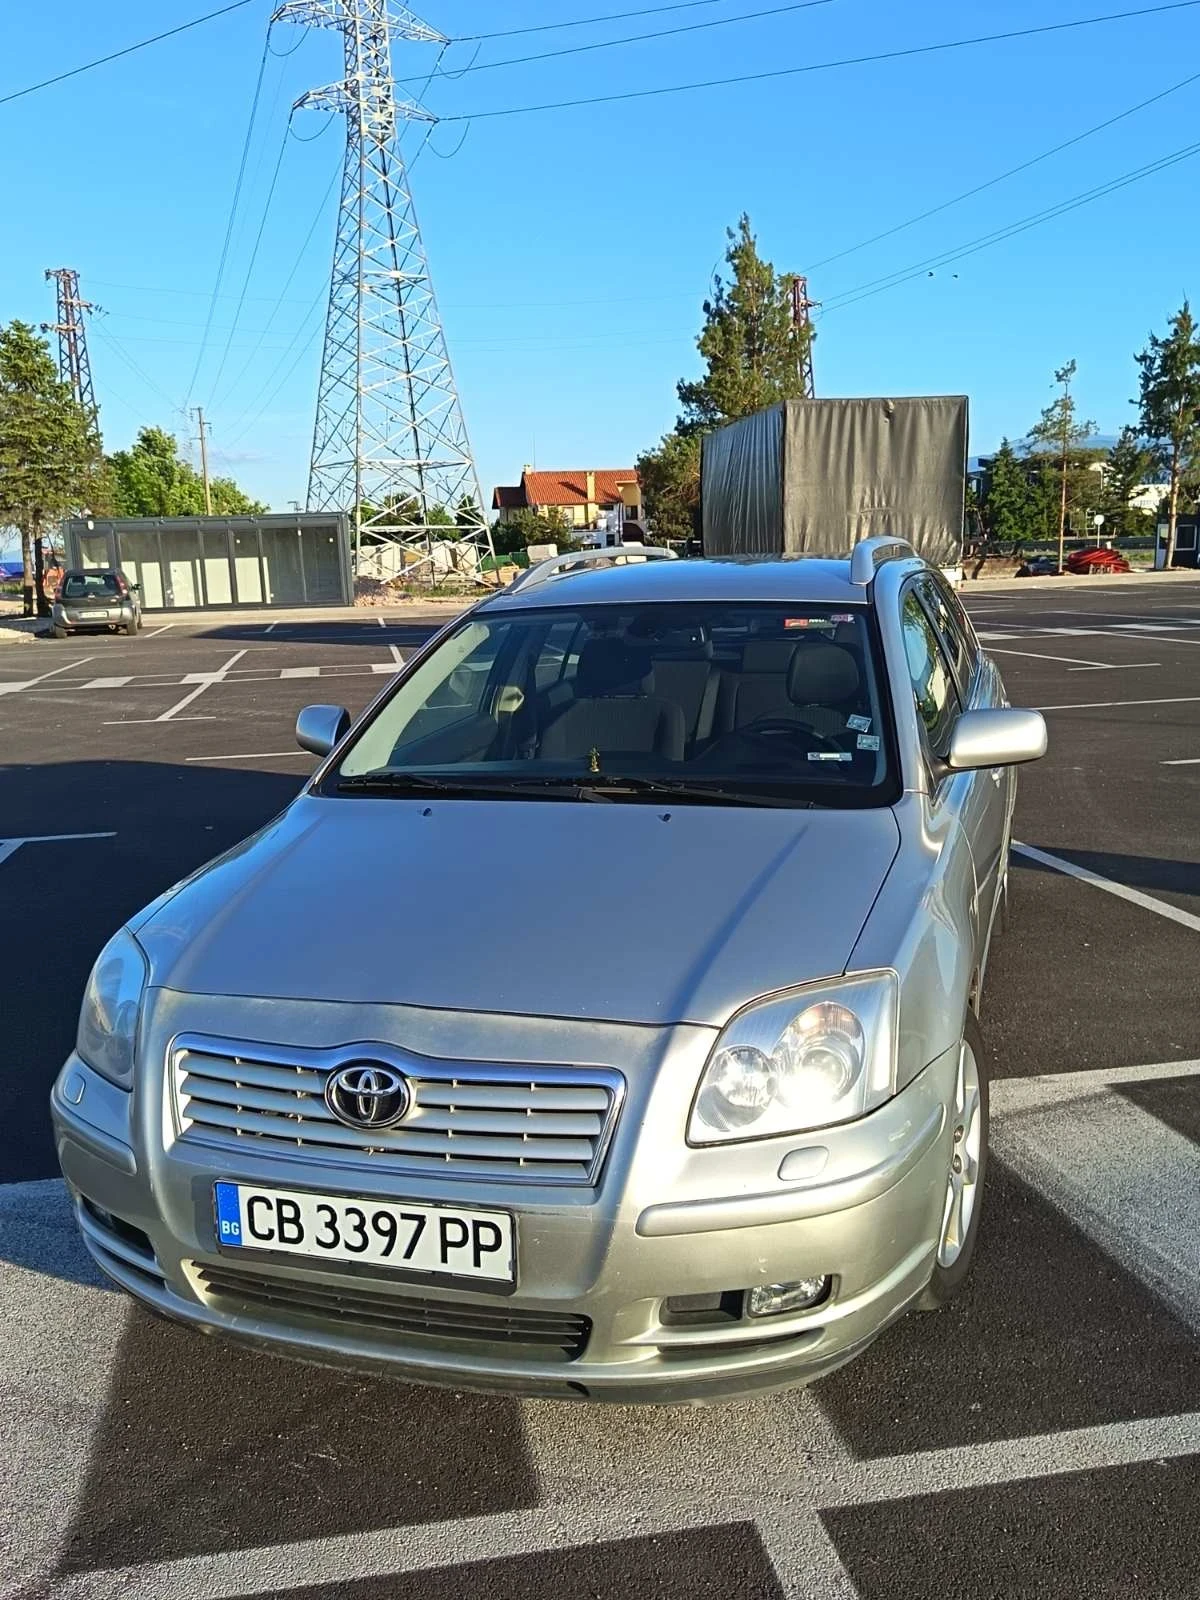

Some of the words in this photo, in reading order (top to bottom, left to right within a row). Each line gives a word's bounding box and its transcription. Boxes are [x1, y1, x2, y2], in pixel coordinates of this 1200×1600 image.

[221, 1220, 240, 1236] BG
[247, 1195, 305, 1245] CB
[315, 1204, 427, 1260] 3397
[440, 1216, 502, 1268] PP
